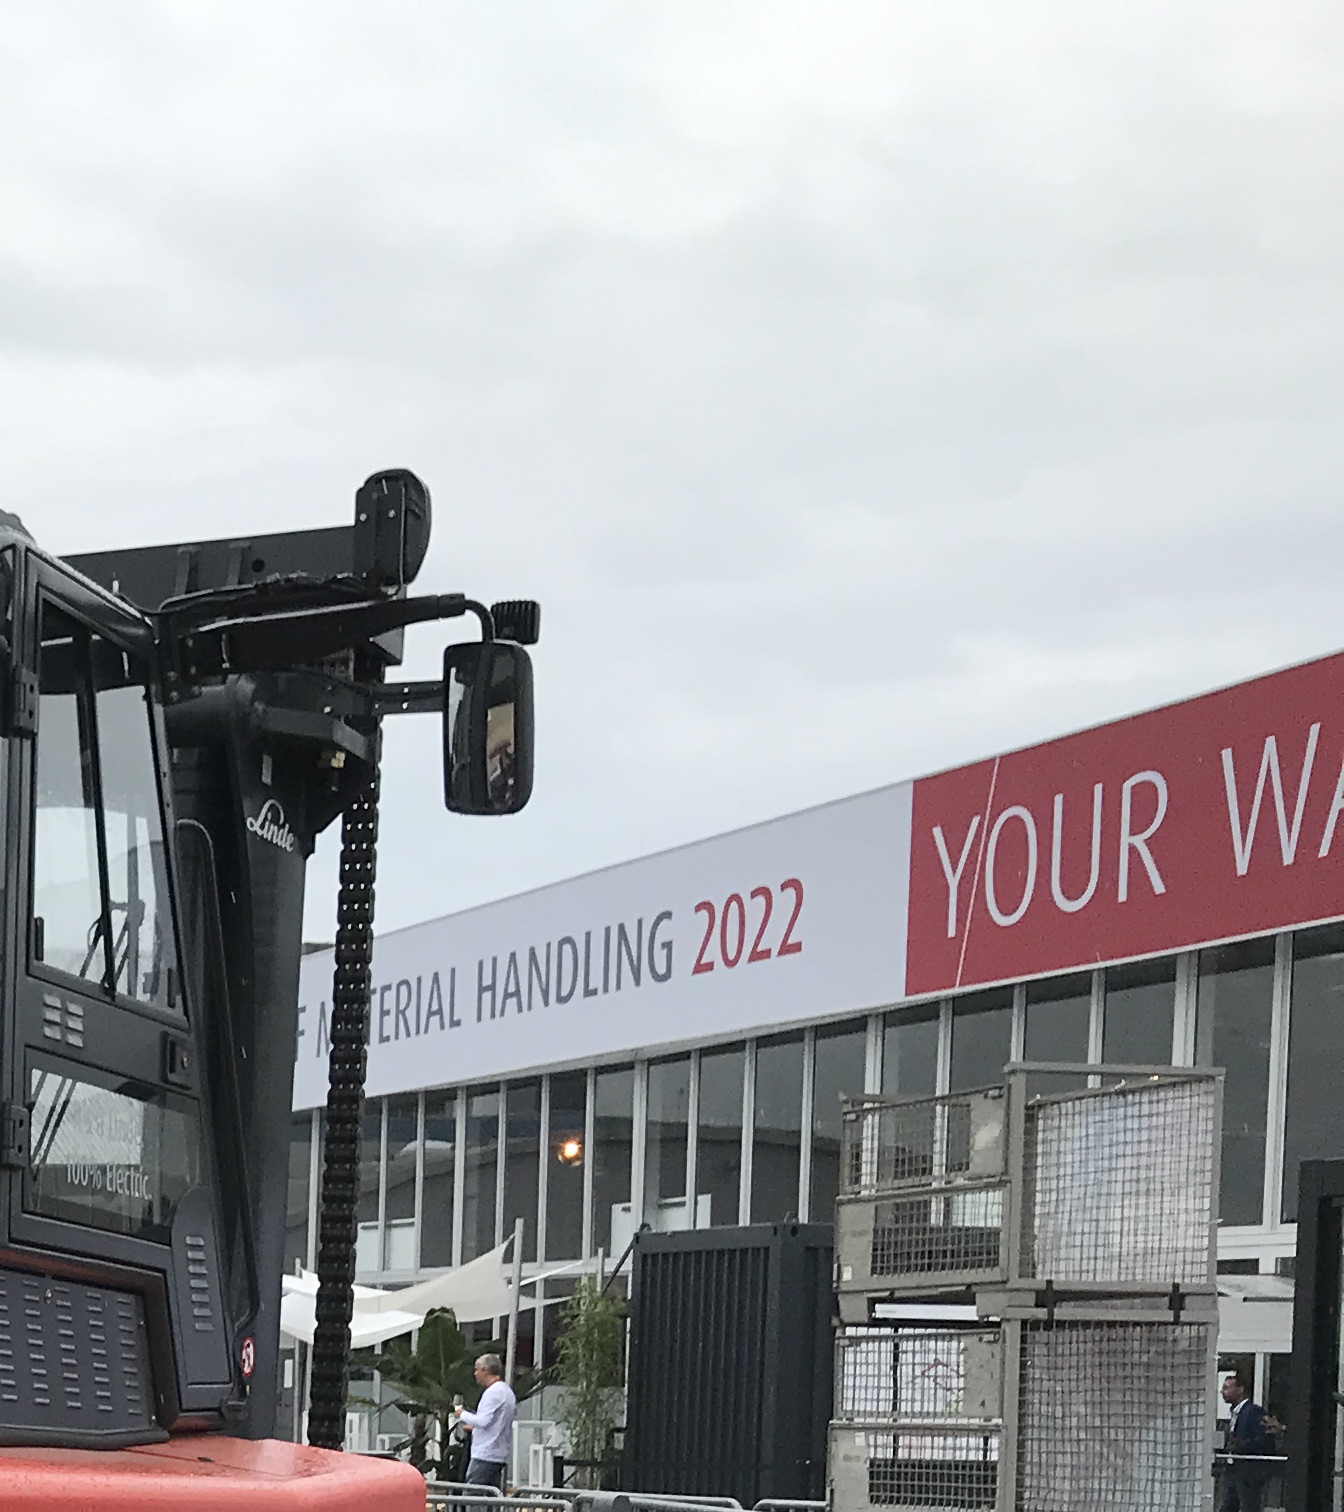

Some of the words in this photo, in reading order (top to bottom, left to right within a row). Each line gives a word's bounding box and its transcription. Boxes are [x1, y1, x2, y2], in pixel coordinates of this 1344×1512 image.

[246, 799, 295, 852] Linde
[932, 769, 1168, 938] YOUR
[475, 910, 674, 1024] HANDLING
[691, 877, 804, 976] 2022
[106, 1162, 153, 1200] Electric.
